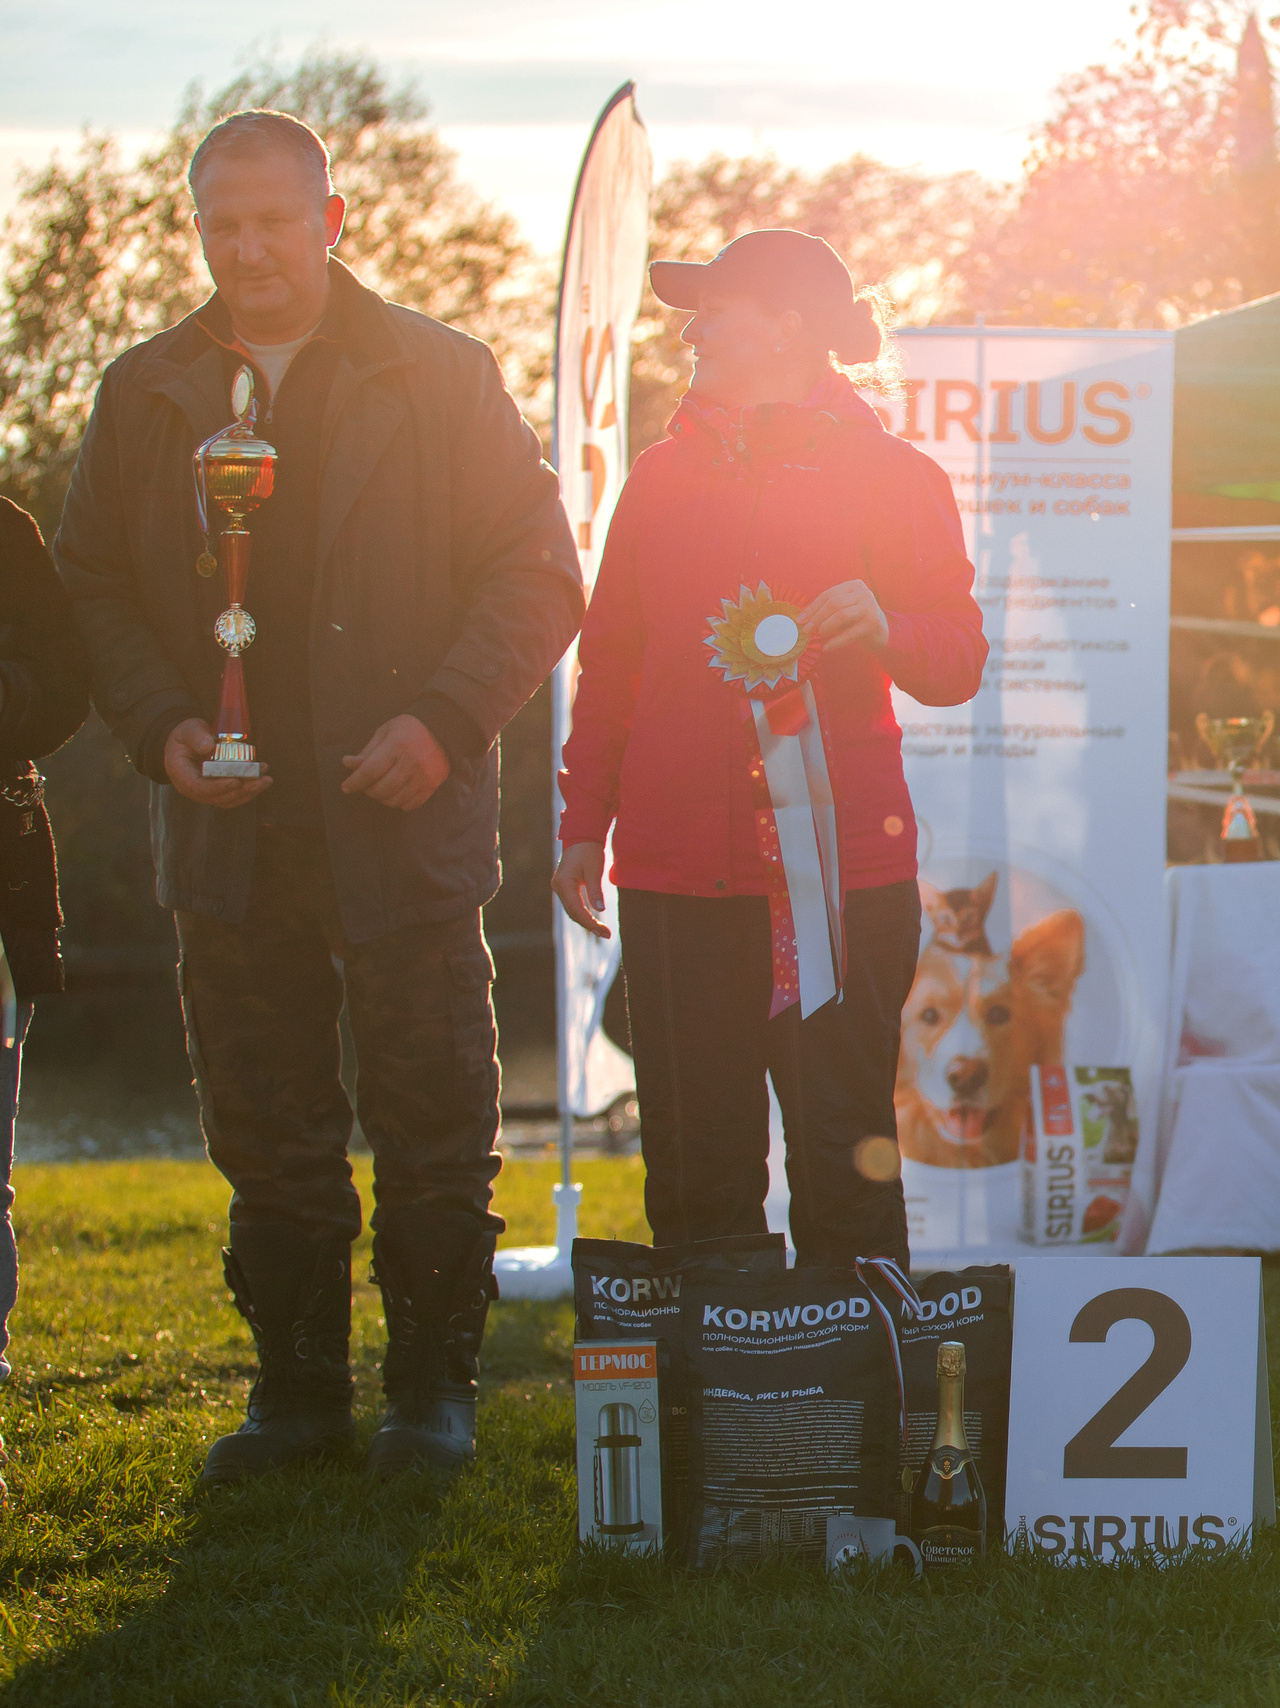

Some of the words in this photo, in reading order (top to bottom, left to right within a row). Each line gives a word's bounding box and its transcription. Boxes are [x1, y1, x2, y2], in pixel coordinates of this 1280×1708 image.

[1053, 494, 1131, 515] собак
[1047, 1145, 1075, 1239] SIRIUS
[591, 1275, 682, 1302] KORW
[703, 1298, 871, 1331] KORWOOD
[922, 1321, 955, 1331] СУХОЙ
[956, 1314, 984, 1327] КОРМ
[703, 1331, 804, 1345] ПОЛНОРАЦИОННЫЙ
[807, 1324, 838, 1339] СУХОЙ
[841, 1324, 869, 1332] КОРМ
[578, 1353, 652, 1371] ТЕРМОС
[583, 1382, 616, 1391] МОДЕЛЬ
[1063, 1287, 1192, 1479] 2
[703, 1389, 754, 1402] ИНДЕЙКА,
[757, 1392, 778, 1400] РИС
[781, 1390, 789, 1398] И
[792, 1386, 824, 1397] РЫБА
